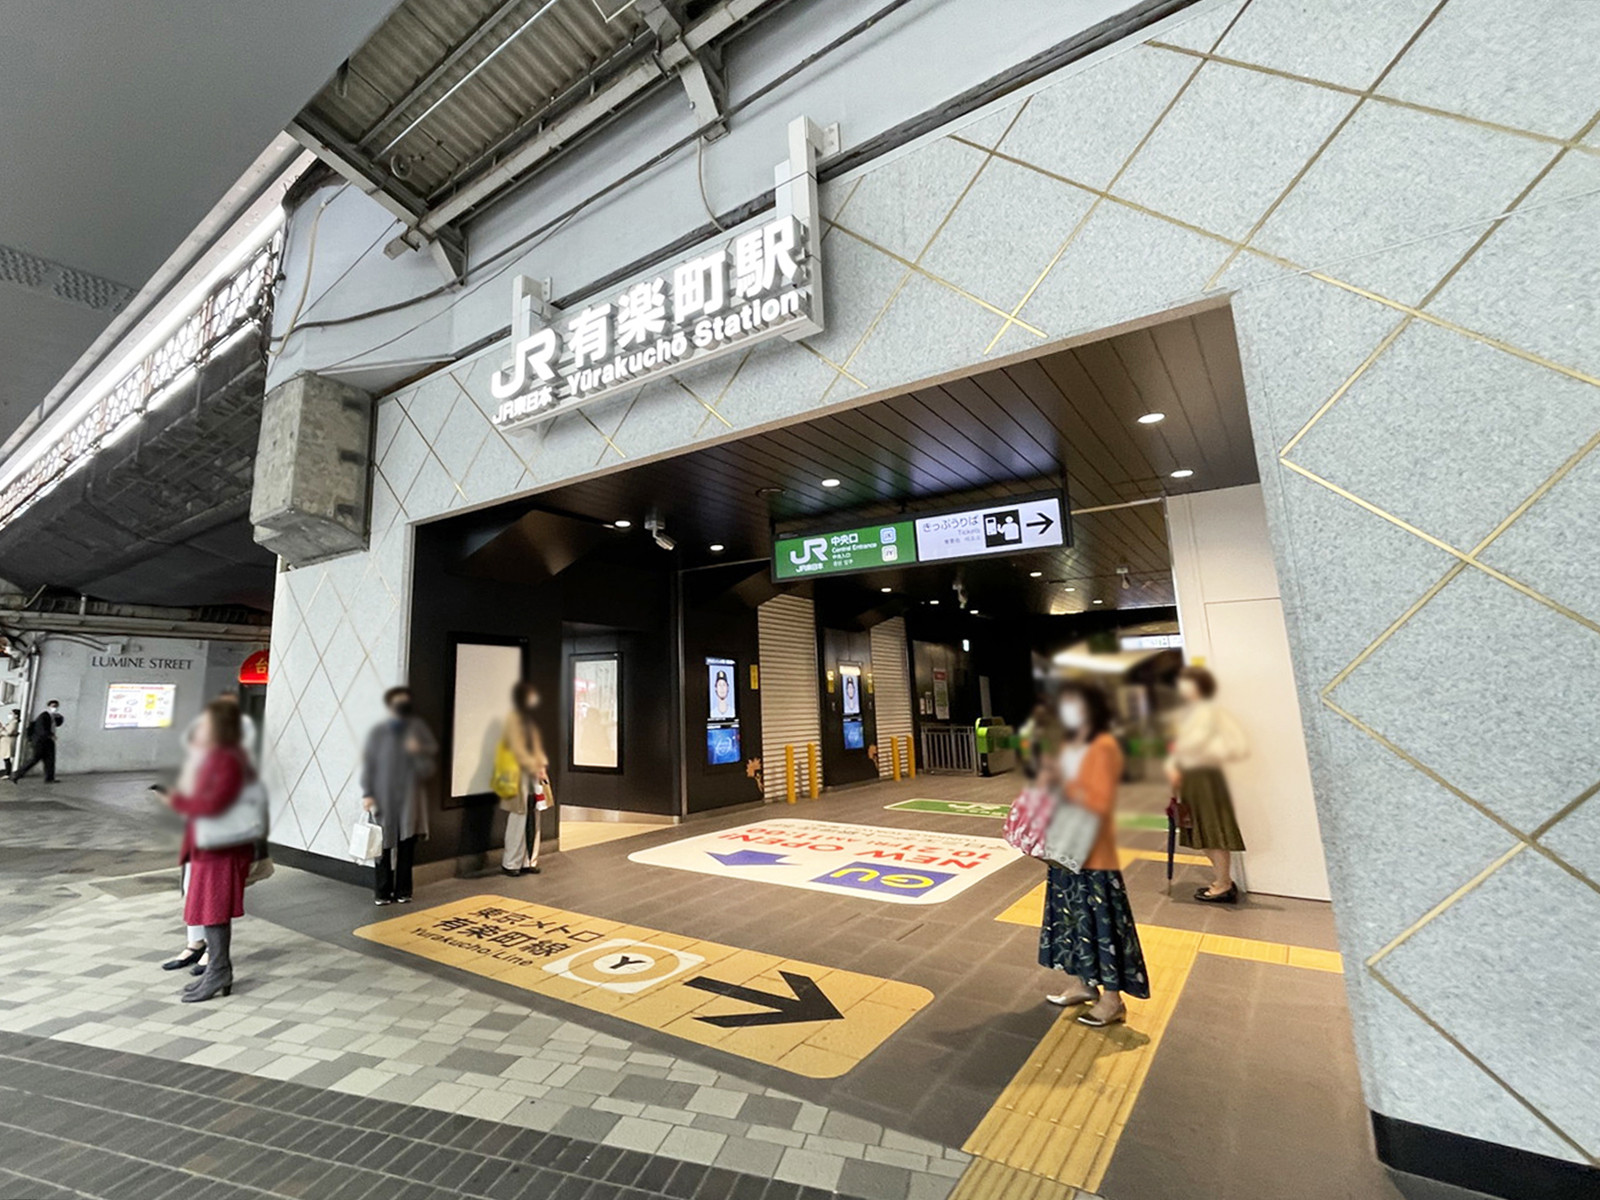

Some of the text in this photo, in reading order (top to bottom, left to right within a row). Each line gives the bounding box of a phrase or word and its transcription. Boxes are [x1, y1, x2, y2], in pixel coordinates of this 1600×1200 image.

[568, 214, 798, 367] 有楽町駅
[694, 289, 799, 347] Station
[491, 327, 556, 398] JR
[923, 515, 979, 533] きっぷうりば
[790, 538, 828, 564] JR
[830, 533, 859, 546] 中央口
[91, 656, 194, 670] LUMINE STREET
[853, 850, 981, 869] NEW
[830, 866, 935, 889] GU
[432, 916, 571, 958] 有楽町線
[468, 906, 605, 943] 東京メトロ
[410, 927, 534, 967] Yurakucho Line
[610, 955, 646, 970] Y
